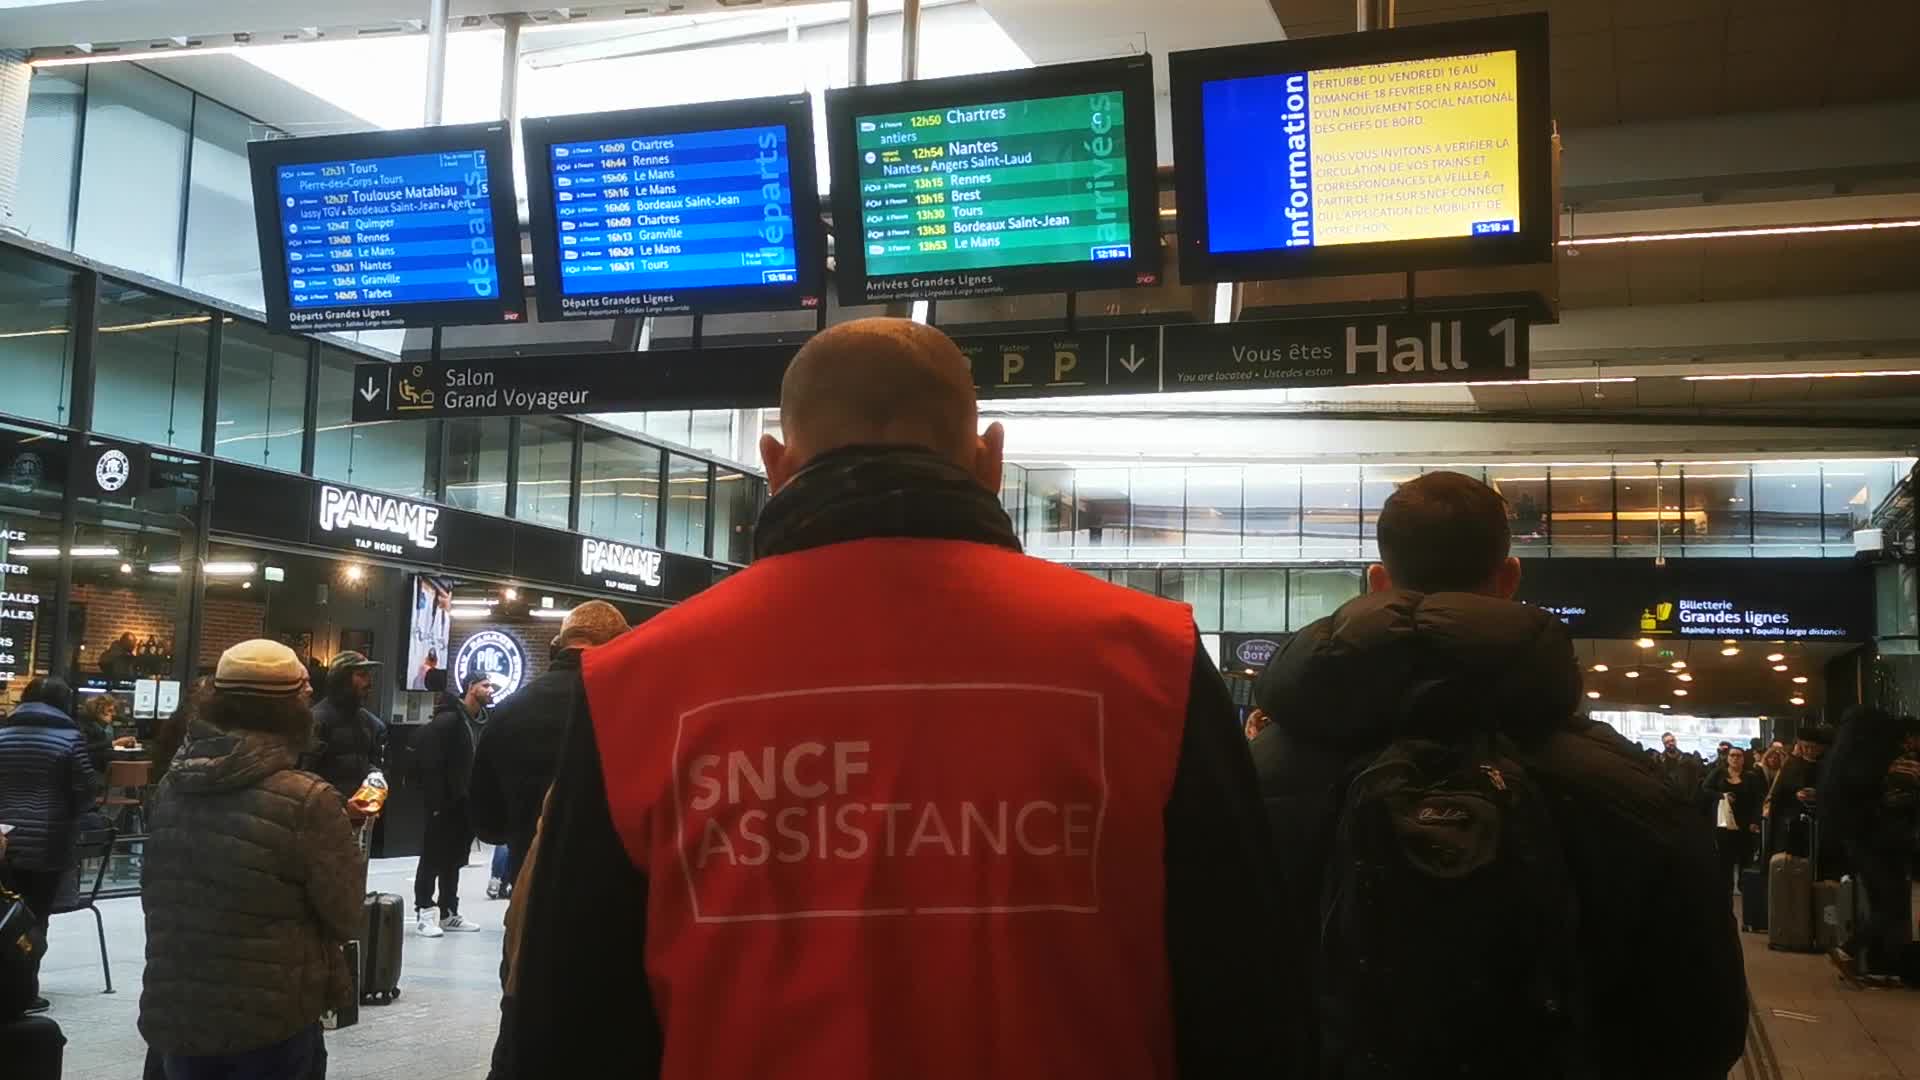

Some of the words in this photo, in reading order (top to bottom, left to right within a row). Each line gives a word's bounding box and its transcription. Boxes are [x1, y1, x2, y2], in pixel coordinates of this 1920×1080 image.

[1313, 73, 1367, 89] PERTURBE
[1369, 72, 1386, 84] DU
[1389, 68, 1445, 83] VENDREDI
[1449, 67, 1461, 76] 16
[1462, 65, 1479, 75] AU
[1313, 90, 1370, 105] DIMANCHE
[1375, 88, 1386, 98] 18
[1436, 82, 1450, 92] EN
[1455, 79, 1497, 91] RAISON
[1343, 100, 1412, 117] MOUVEMENT
[1415, 97, 1456, 110] SOCIAL
[1457, 91, 1515, 106] NATIONAL
[911, 114, 942, 128] 12h50
[946, 107, 1007, 124] Chartres
[1314, 122, 1336, 134] DES
[1338, 118, 1372, 131] CHEFS
[1375, 117, 1390, 129] DE
[631, 138, 675, 152] Chartres
[912, 146, 944, 160] 12h54
[948, 140, 999, 156] Nantes
[1315, 152, 1345, 164] NOUS
[1349, 149, 1378, 161] VOUS
[1380, 144, 1433, 158] INVITONS
[1496, 137, 1510, 149] LA
[348, 162, 379, 175] Tours
[479, 154, 486, 165] 7
[633, 154, 670, 166] Rennes
[882, 163, 922, 177] Nantes
[930, 158, 970, 175] Angers
[971, 152, 1033, 169] Saint-Laud
[1084, 94, 1119, 242] arrivées
[1282, 74, 1310, 247] information
[1316, 162, 1386, 178] CIRCULATION
[1389, 160, 1404, 171] DE
[1407, 158, 1429, 171] VOS
[1432, 156, 1471, 170] TRAINS
[1474, 155, 1487, 166] ET
[380, 173, 405, 186] Tours
[634, 170, 647, 182] Le
[648, 168, 676, 180] Mans
[913, 177, 944, 190] 13h15
[950, 173, 992, 186] Rennes
[351, 187, 403, 204] Toulouse
[405, 184, 458, 200] Matabiau
[481, 183, 489, 193] 5
[635, 185, 648, 196] Le
[649, 183, 677, 195] Mans
[915, 192, 945, 206] 13h15
[951, 188, 982, 202] Brest
[637, 198, 684, 212] Bordeaux
[685, 194, 740, 209] Saint-Jean
[756, 130, 791, 266] départs
[322, 206, 342, 218] TGV
[346, 203, 390, 217] Bordeaux
[390, 200, 440, 214] Saint-Jean
[916, 208, 945, 221] 13h30
[952, 204, 984, 218] Tours
[354, 218, 395, 233] Quimper
[637, 213, 681, 226] Chartres
[953, 219, 1006, 234] Bordeaux
[1008, 213, 1070, 230] Saint-Jean
[356, 232, 391, 245] Rennes
[463, 171, 496, 297] départs
[638, 227, 684, 241] Granville
[954, 237, 969, 249] Le
[970, 235, 1001, 248] Mans
[358, 247, 370, 258] Le
[370, 245, 396, 257] Mans
[639, 244, 653, 256] Le
[654, 243, 682, 255] Mans
[359, 260, 393, 272] Nantes
[641, 259, 670, 271] Tours
[360, 274, 401, 286] Granville
[866, 279, 909, 291] Arrivées
[911, 276, 956, 289] Grandes
[957, 273, 993, 287] Lignes
[361, 288, 393, 300] Tarbes
[561, 298, 600, 310] Départs
[601, 295, 641, 307] Grandes
[643, 293, 675, 306] Lignes
[289, 311, 323, 323] Départs
[325, 309, 361, 320] Grandes
[362, 307, 391, 320] Lignes
[1231, 344, 1283, 363] Vous
[1288, 342, 1334, 361] êtes
[1346, 319, 1470, 375] Hall
[1488, 317, 1517, 368] 1
[1003, 352, 1025, 384] P
[1055, 351, 1077, 382] P
[1177, 371, 1197, 383] You
[1198, 371, 1215, 382] are
[1215, 369, 1253, 382] located
[445, 368, 495, 388] Salon
[444, 390, 498, 410] Grand
[503, 388, 590, 411] Voyageur
[319, 485, 439, 549] PANAME
[355, 538, 372, 550] TAP
[374, 541, 404, 556] HOUSE
[582, 538, 662, 587] PANAME
[1679, 599, 1734, 610] Billetterie
[1679, 609, 1742, 623] Grandes
[1745, 609, 1790, 627] lignes
[1680, 626, 1716, 635] Mainline
[1717, 626, 1744, 636] tickets
[689, 740, 870, 811] SNCF
[698, 799, 1093, 869] ASSISTANCE
